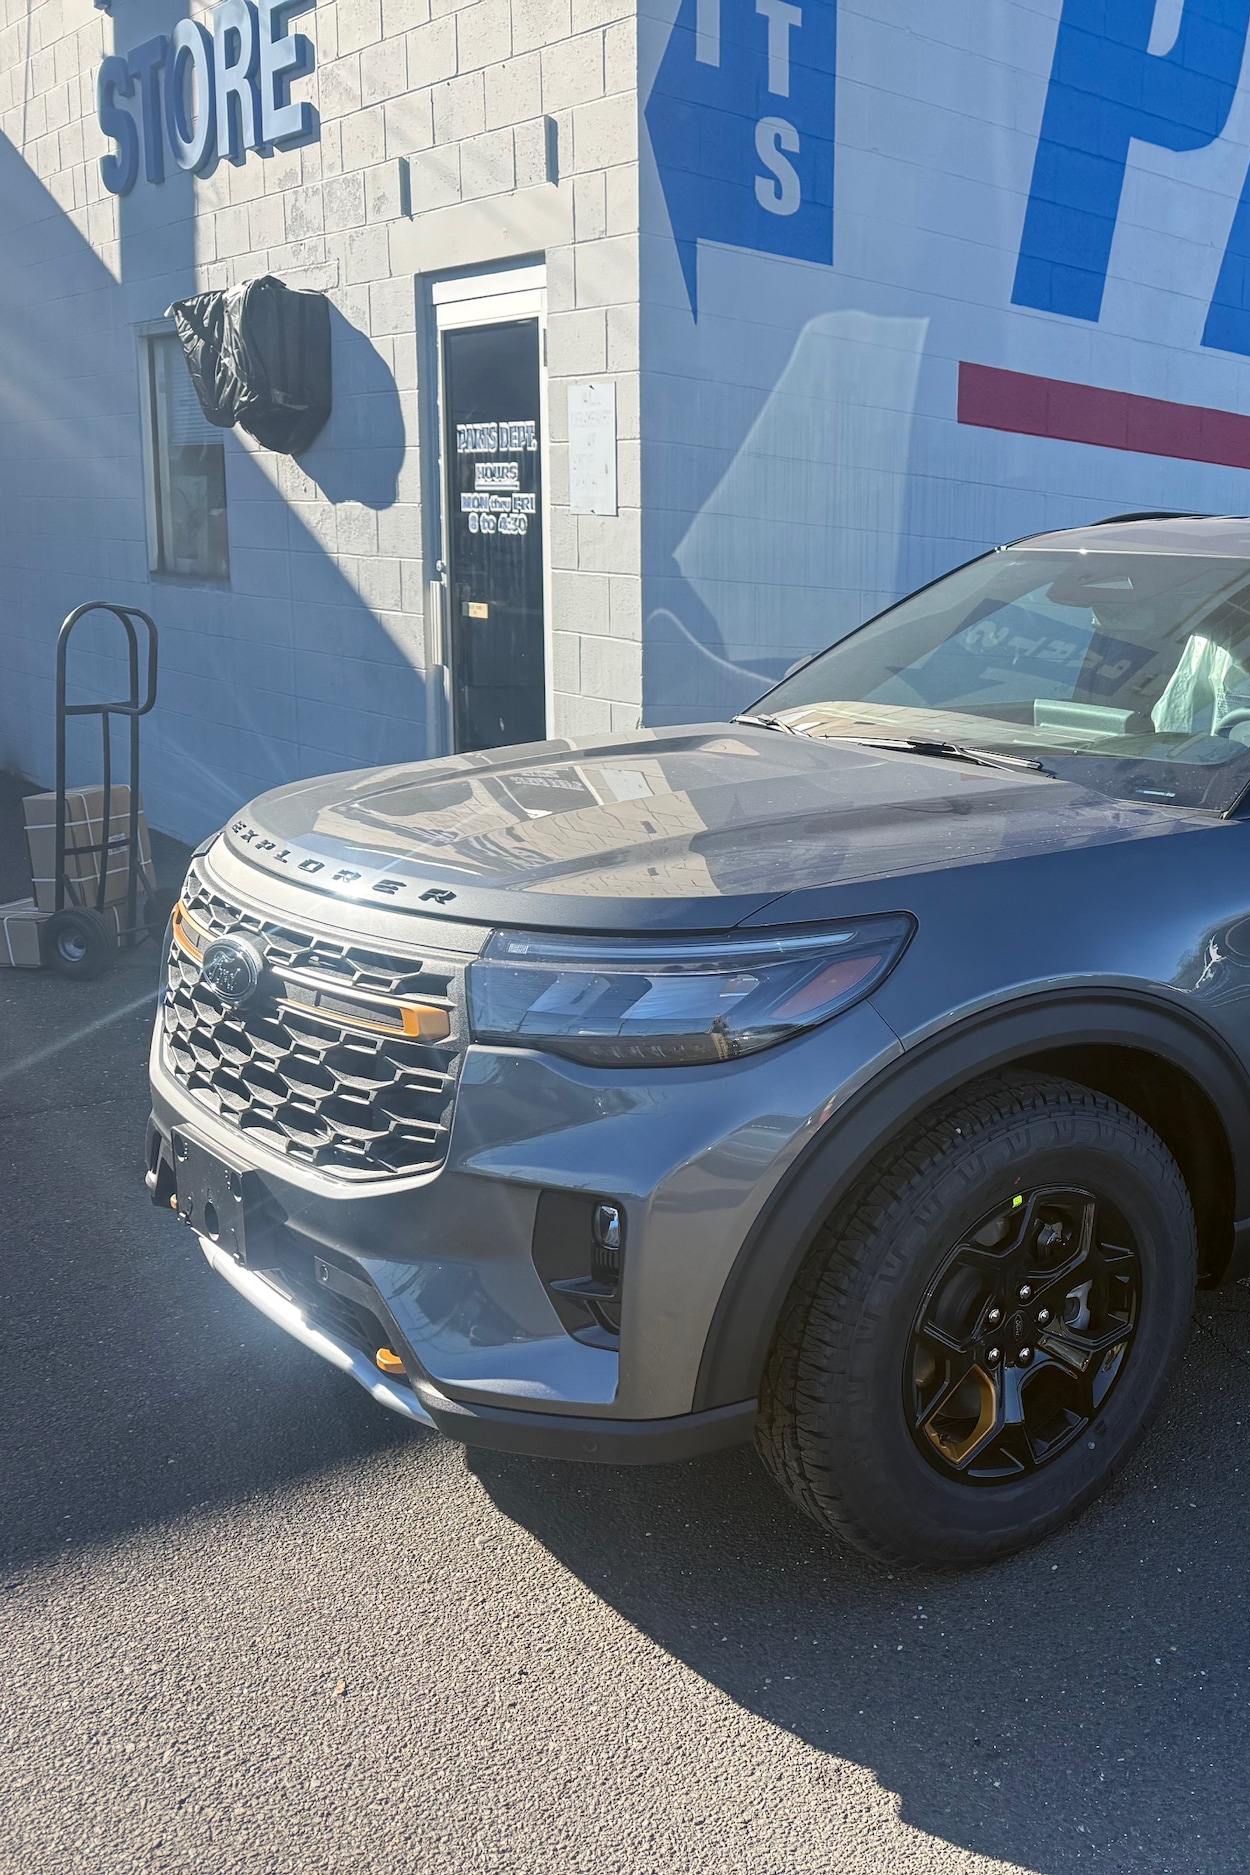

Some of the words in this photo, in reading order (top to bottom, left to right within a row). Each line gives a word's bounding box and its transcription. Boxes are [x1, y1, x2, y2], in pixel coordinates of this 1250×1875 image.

[97, 0, 306, 195] STORE
[456, 422, 498, 453] PARTS
[475, 462, 518, 482] HOURS
[461, 492, 489, 512] MON
[512, 492, 536, 513] FRI
[468, 512, 479, 533] 8
[480, 512, 497, 534] to
[231, 820, 458, 905] EXPLORER
